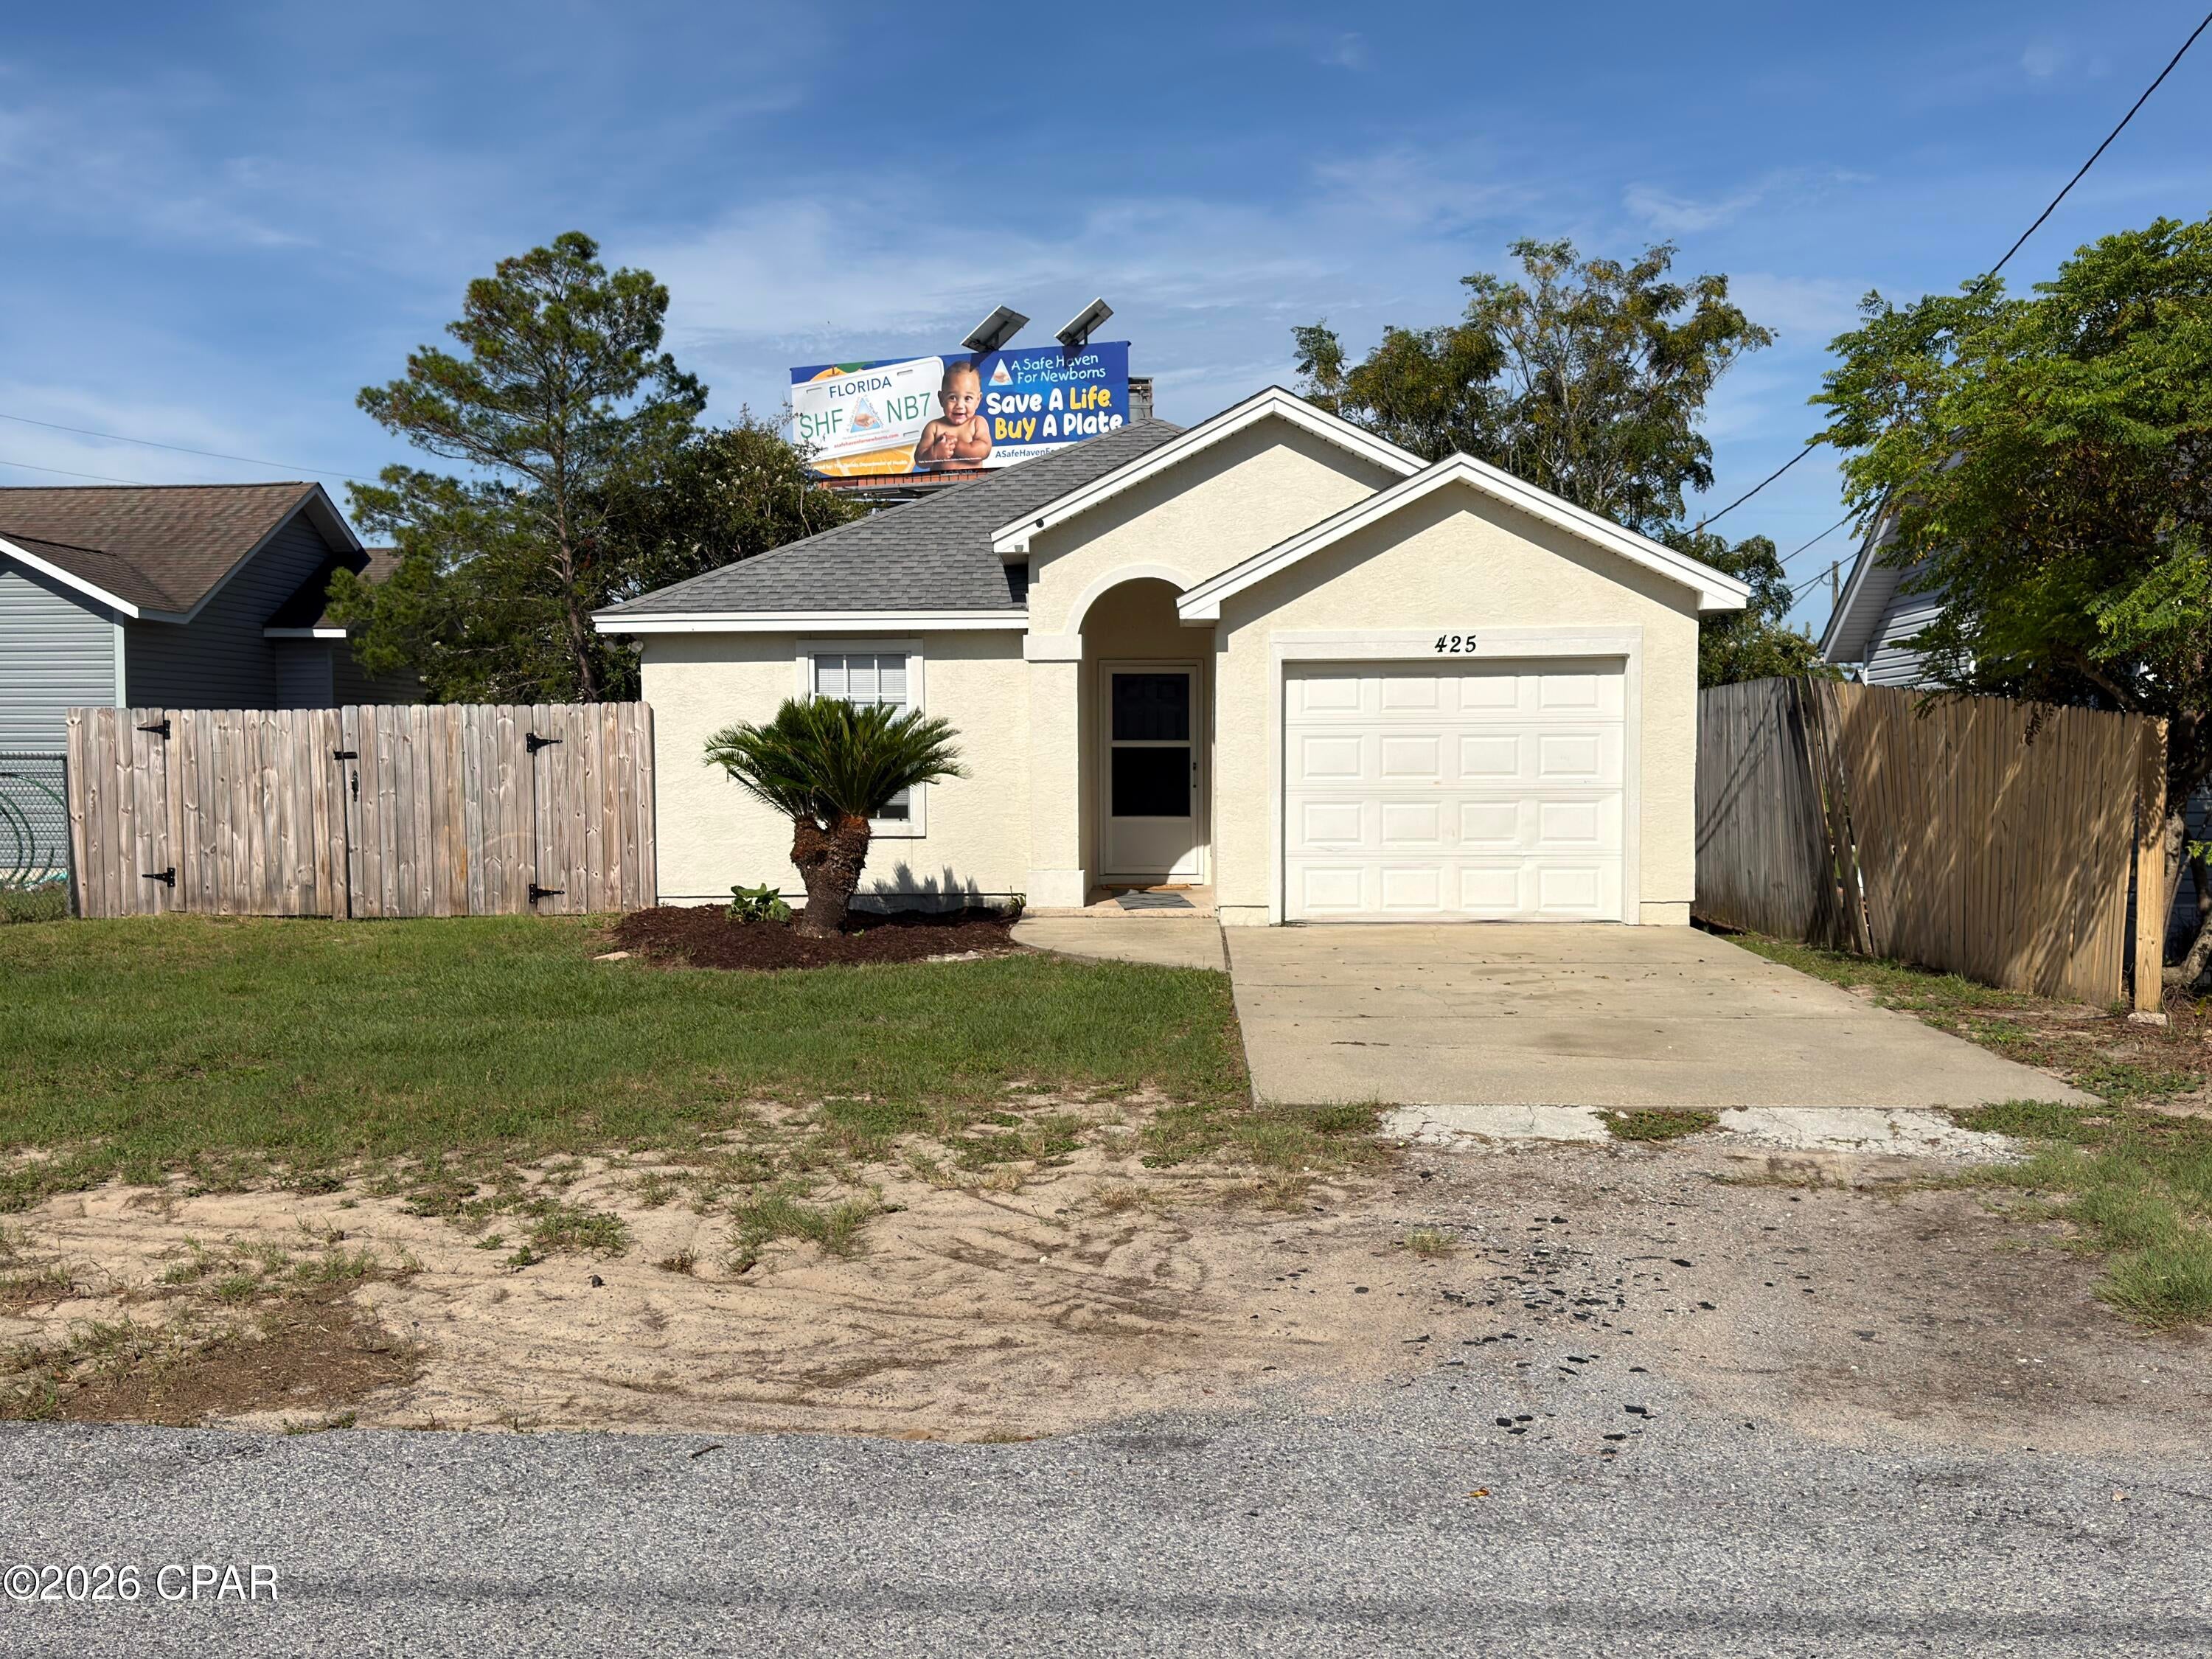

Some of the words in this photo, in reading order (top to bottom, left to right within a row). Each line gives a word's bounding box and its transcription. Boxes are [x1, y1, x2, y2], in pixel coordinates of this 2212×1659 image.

[1011, 360, 1020, 371] A
[1023, 357, 1053, 370] Safe
[1057, 355, 1099, 369] Haven
[1018, 372, 1037, 384] For
[1040, 367, 1107, 383] Newborns
[830, 376, 891, 398] FLORIDA
[986, 392, 1043, 415] Save
[1048, 388, 1064, 411] A
[1070, 385, 1112, 411] Life.
[886, 392, 931, 423] NB7
[799, 408, 843, 439] SHF
[995, 417, 1037, 442] Buy
[1043, 414, 1057, 437] A
[1063, 411, 1124, 437] Plate
[1434, 634, 1476, 653] 425
